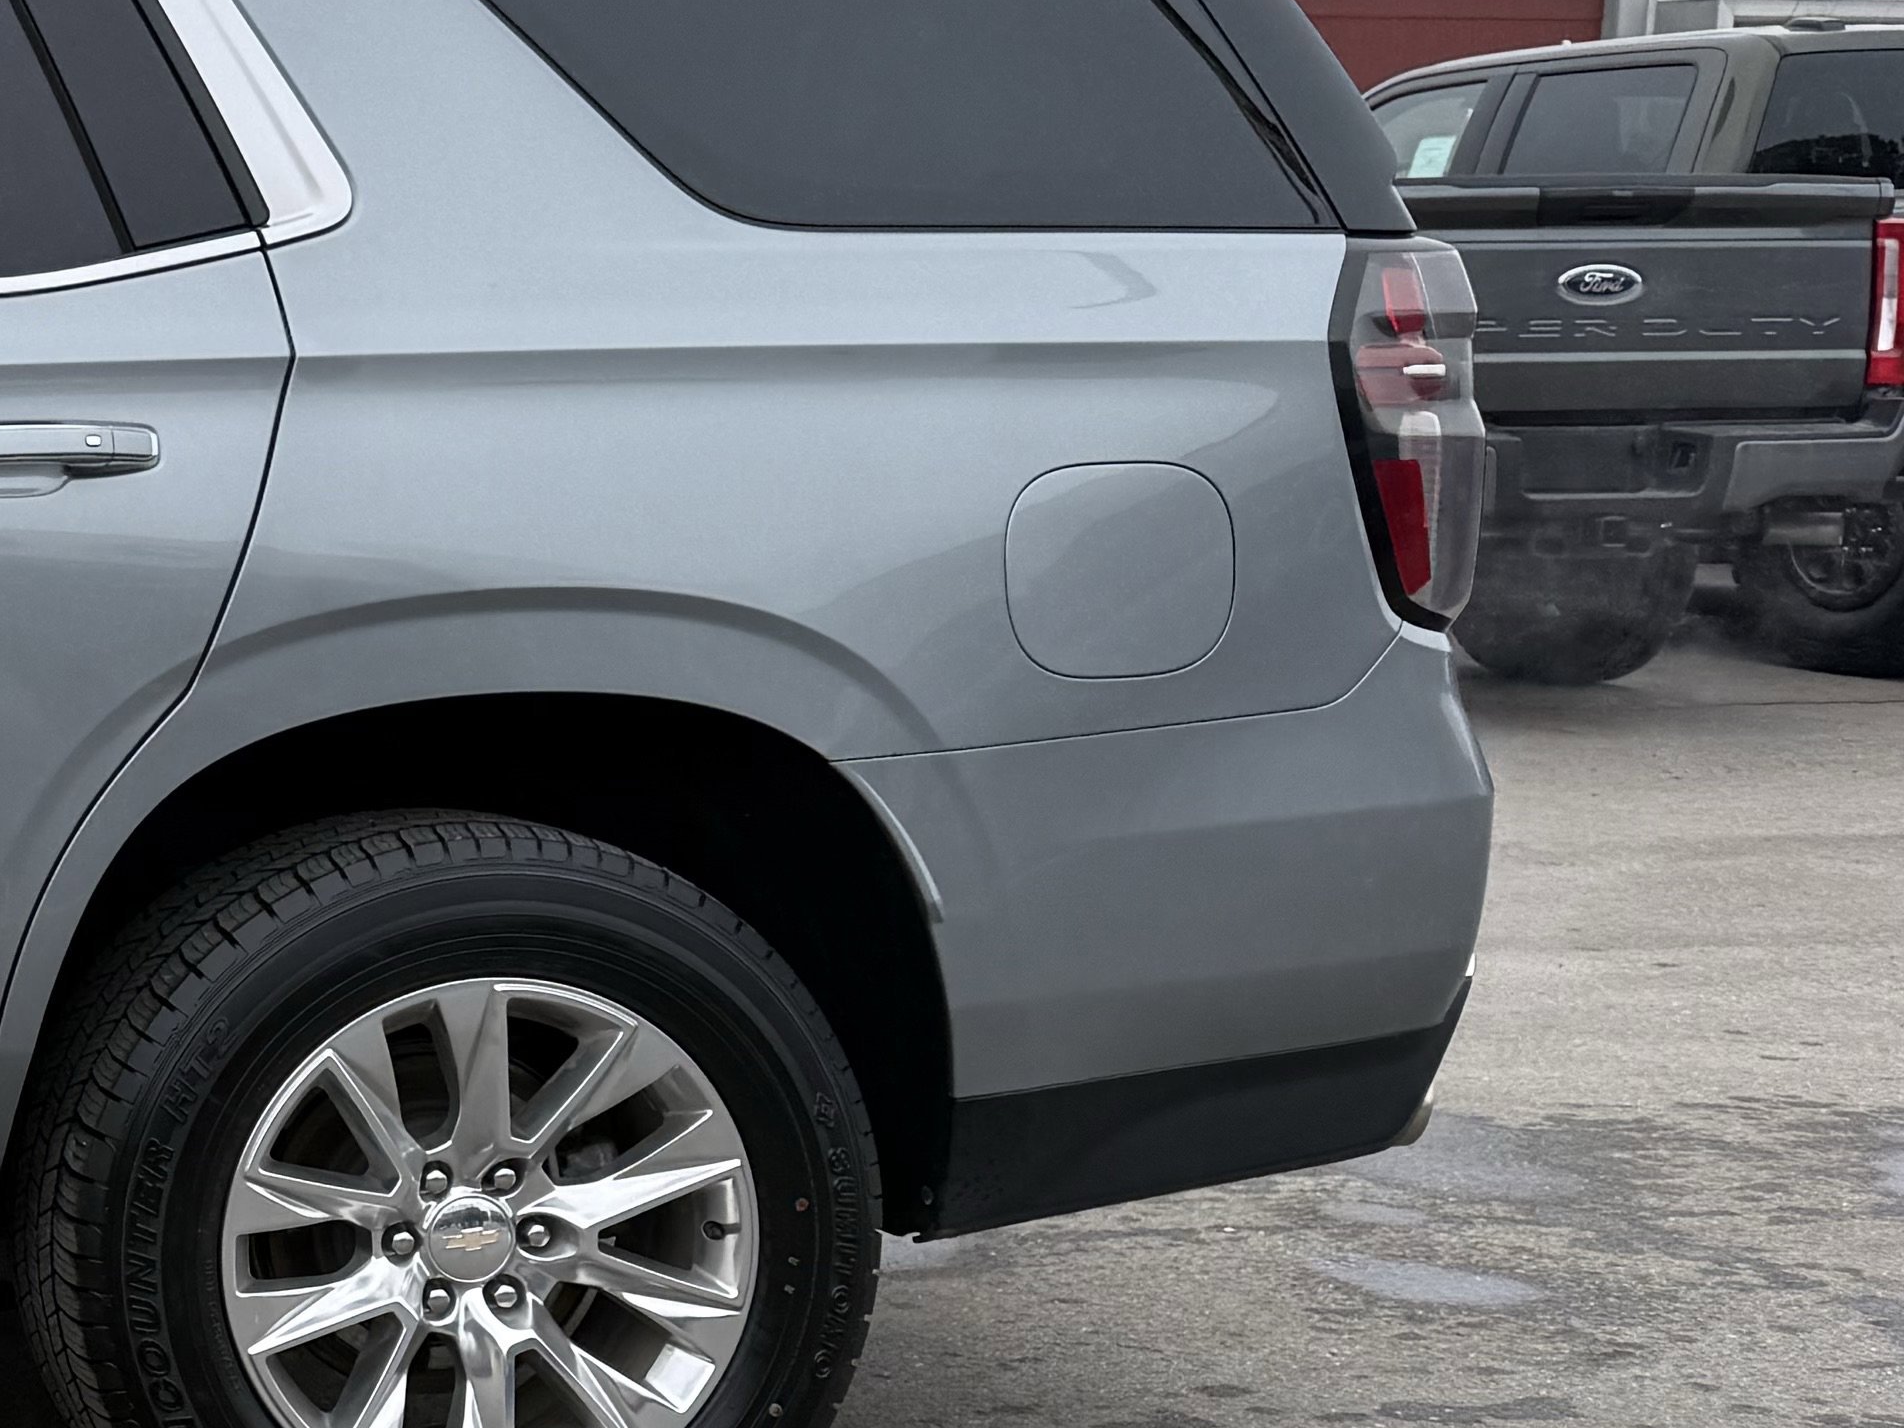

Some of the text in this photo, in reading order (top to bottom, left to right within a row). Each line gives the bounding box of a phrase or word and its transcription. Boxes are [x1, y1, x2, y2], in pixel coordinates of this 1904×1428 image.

[1476, 317, 1841, 338] PER DUTY
[159, 1014, 240, 1126] HT2
